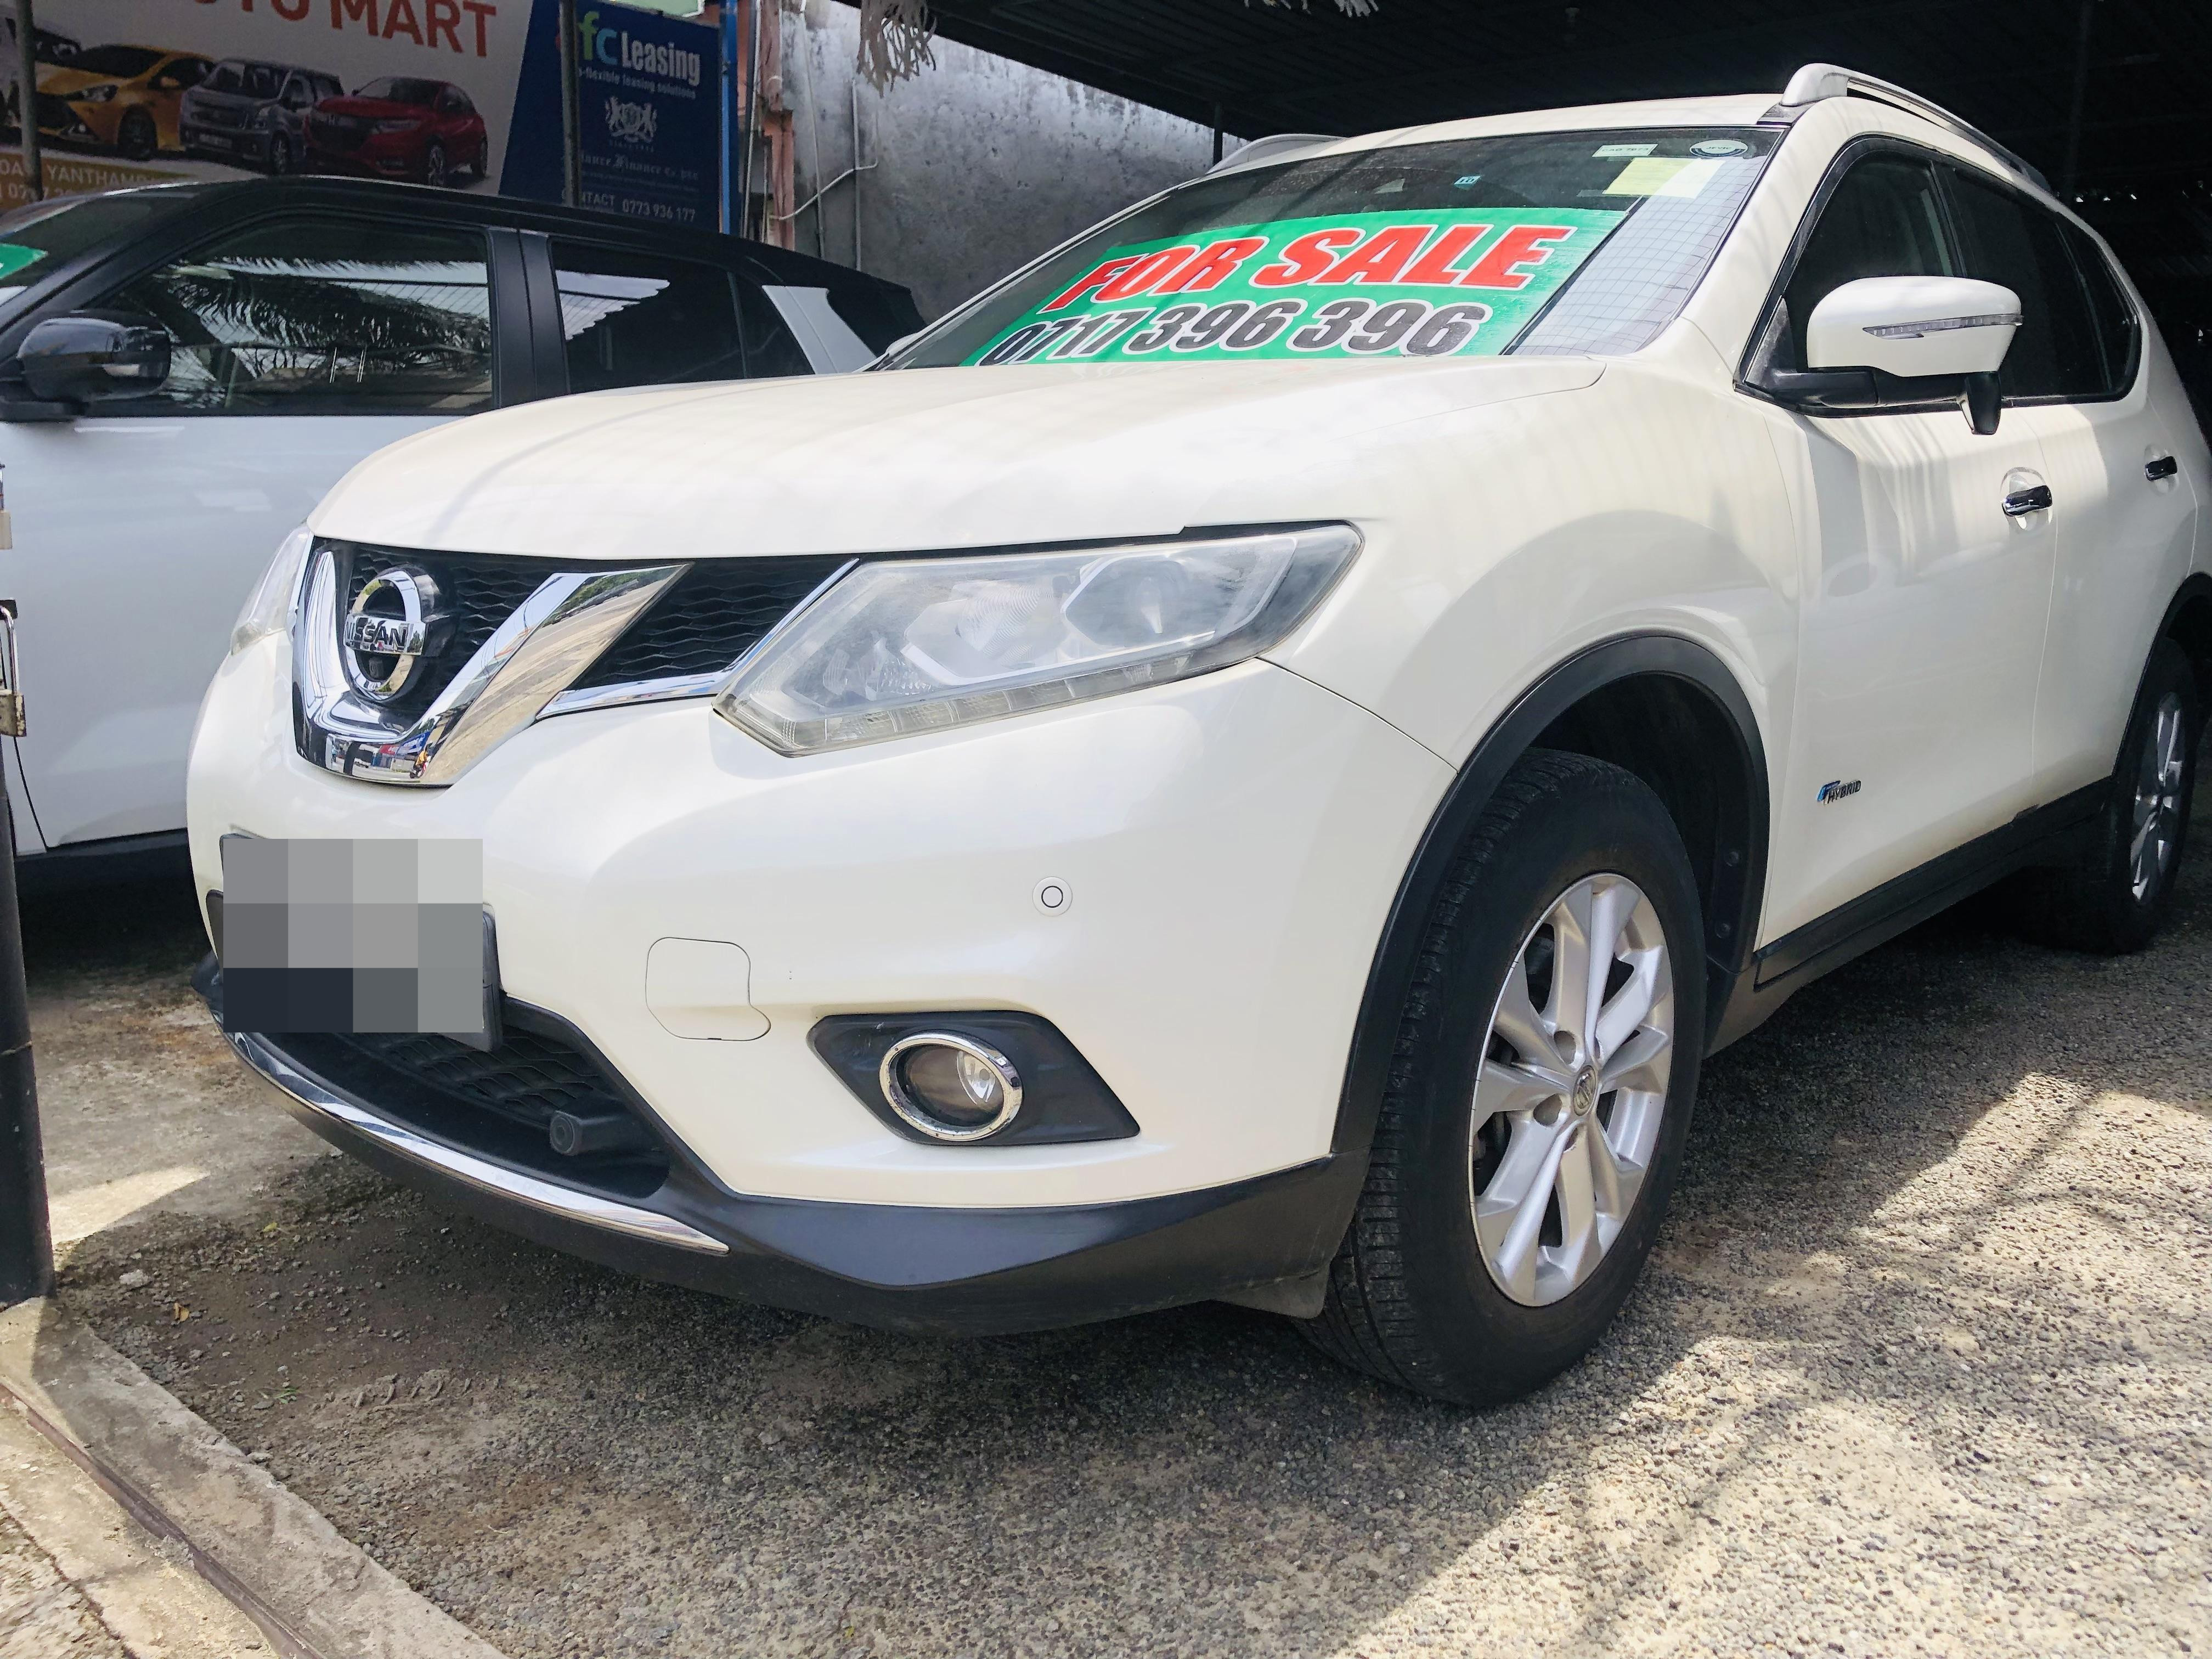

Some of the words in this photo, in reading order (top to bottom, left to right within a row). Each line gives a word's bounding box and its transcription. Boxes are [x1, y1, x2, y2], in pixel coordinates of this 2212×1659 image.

[331, 0, 497, 58] MART
[621, 31, 701, 86] Leasing
[623, 199, 650, 215] 0773
[676, 207, 696, 222] 177
[1037, 237, 1269, 314] FOR
[1249, 224, 1577, 289] SALE
[975, 307, 1156, 366] 0717
[1122, 300, 1308, 354] 396
[1286, 298, 1493, 356] 396
[346, 619, 409, 648] NISSAN
